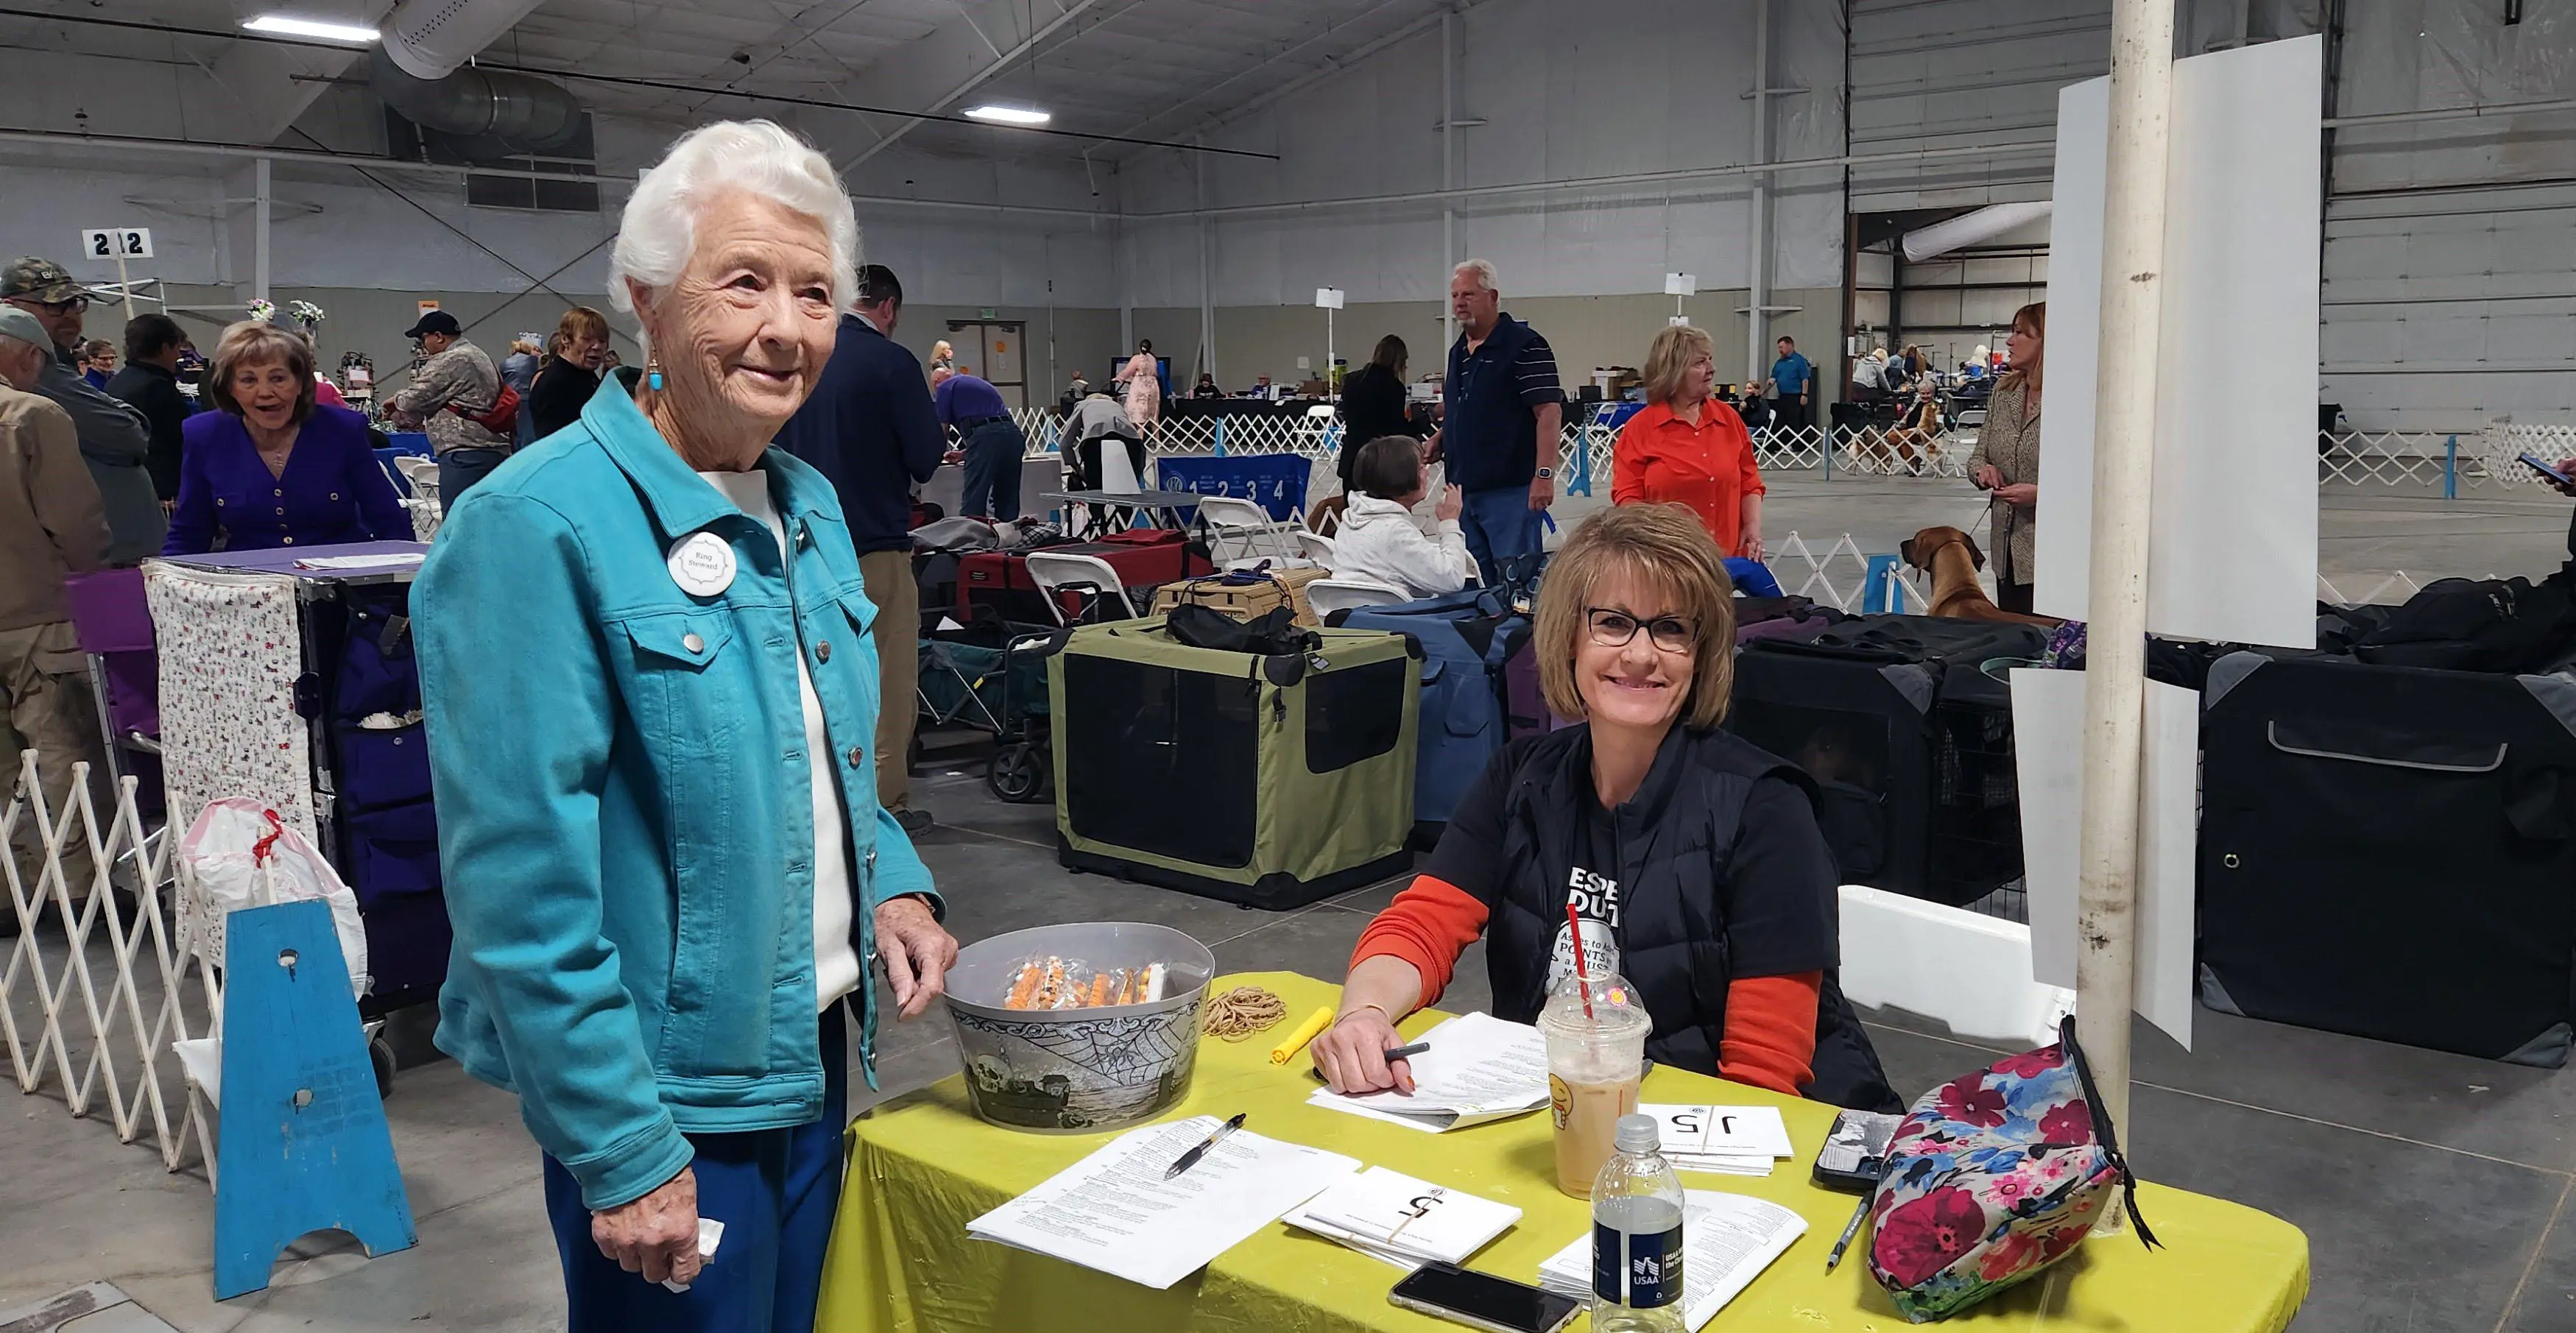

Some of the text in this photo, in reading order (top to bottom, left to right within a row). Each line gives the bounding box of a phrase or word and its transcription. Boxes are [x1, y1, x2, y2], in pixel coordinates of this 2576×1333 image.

[93, 233, 110, 255] 2
[127, 233, 144, 254] 2
[1189, 481, 1198, 495] 1
[1218, 481, 1229, 498] 2
[1246, 480, 1257, 501] 3
[1274, 480, 1283, 501] 4
[696, 552, 713, 562] Ring
[1561, 932, 1589, 946] Ases
[1560, 943, 1606, 962] PONTS
[1398, 1196, 1444, 1219] 5
[1634, 1276, 1659, 1285] USAA
